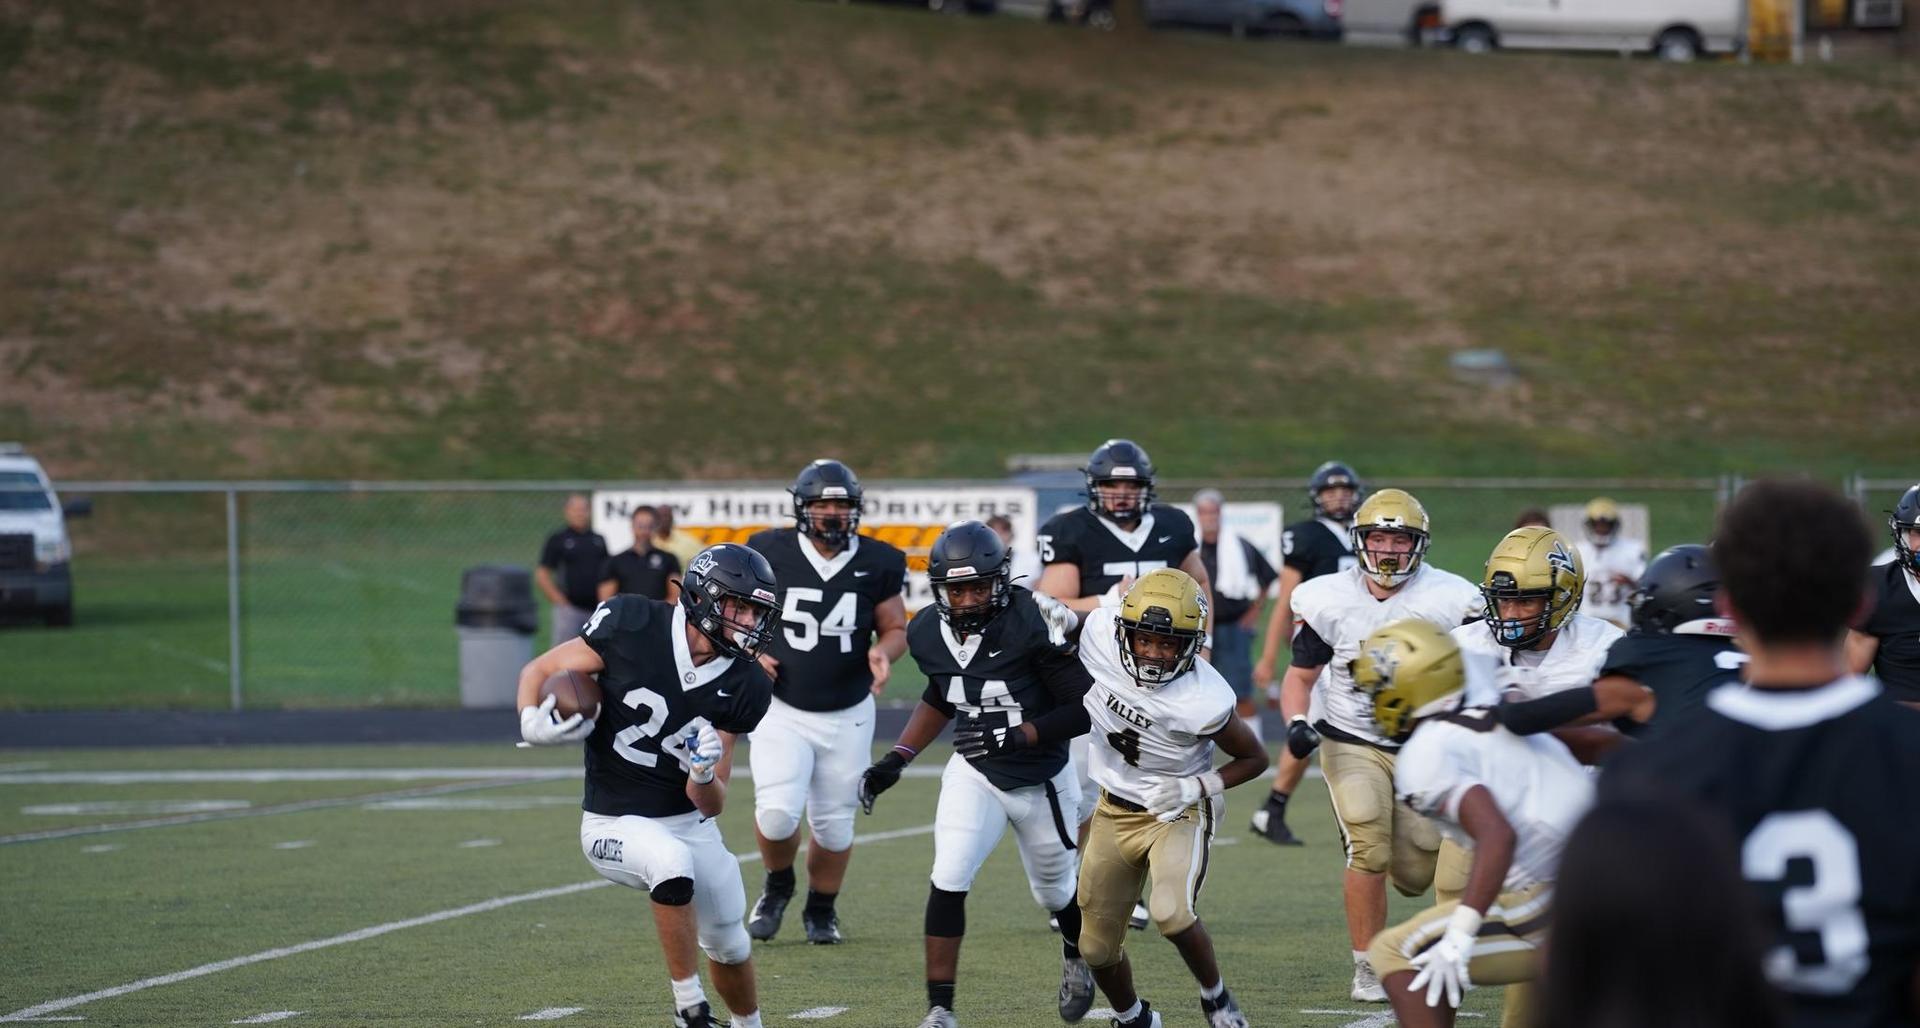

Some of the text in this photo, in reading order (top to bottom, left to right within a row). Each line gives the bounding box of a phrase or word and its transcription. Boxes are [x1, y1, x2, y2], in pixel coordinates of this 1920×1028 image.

[605, 500, 691, 517] NW
[863, 499, 1024, 516] DRIVERS
[781, 587, 858, 653] 54
[613, 687, 712, 773] 24
[1107, 694, 1152, 730] VALLEY
[1107, 728, 1140, 768] 4
[1741, 808, 1871, 996] 3
